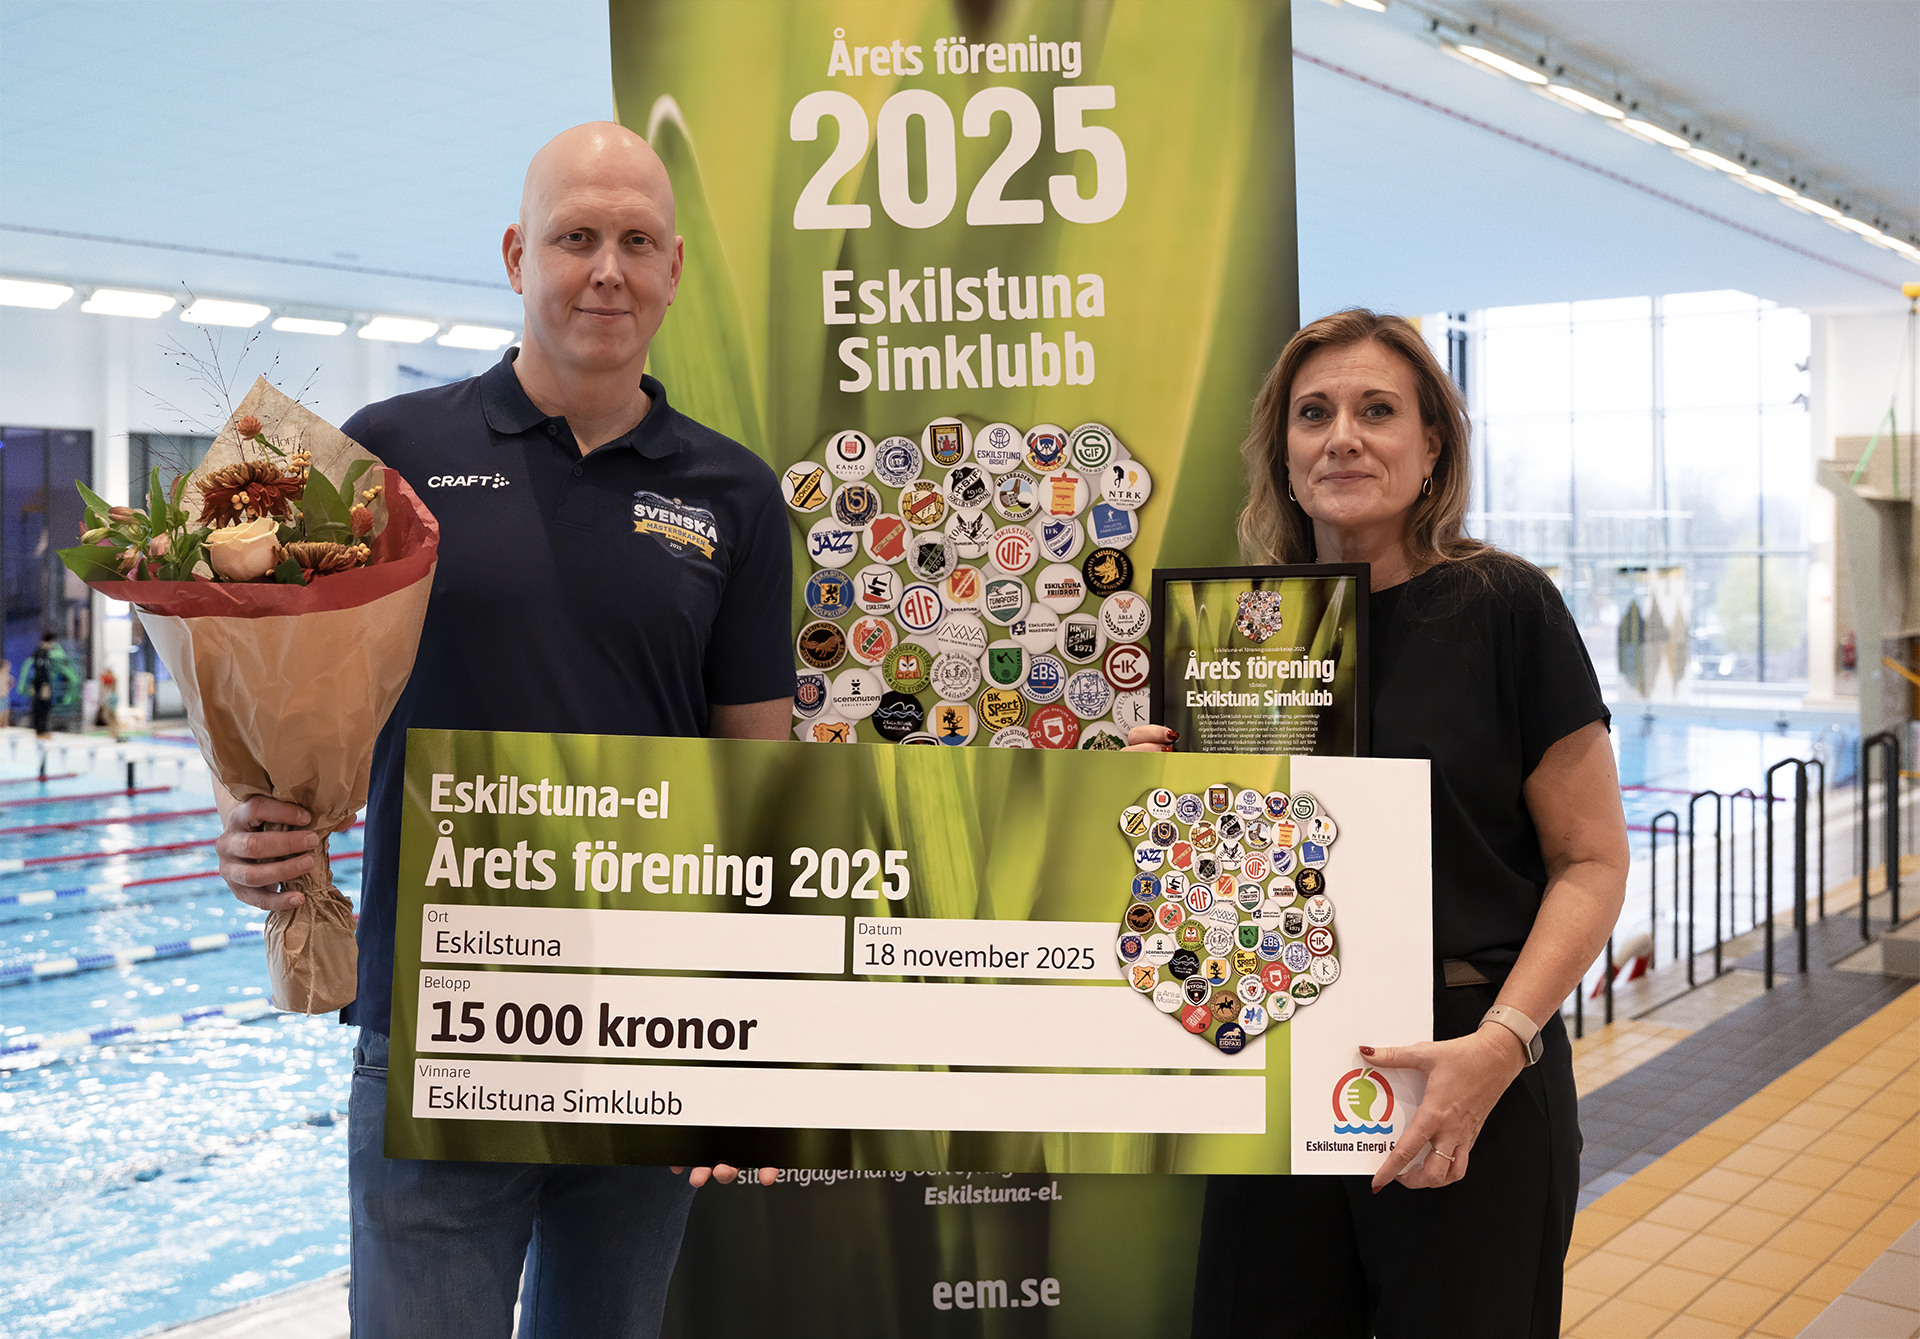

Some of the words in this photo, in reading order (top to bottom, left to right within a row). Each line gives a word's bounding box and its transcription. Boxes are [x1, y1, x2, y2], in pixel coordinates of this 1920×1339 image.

[827, 27, 924, 77] Årets
[933, 34, 1082, 79] förening
[789, 85, 1128, 230] 2025
[822, 266, 1105, 325] Eskilstuna
[838, 331, 1095, 393] Simklubb
[977, 450, 1020, 460] ESKILSTUNA
[1084, 448, 1100, 458] GIF
[428, 475, 492, 488] CRAFT
[1108, 490, 1142, 499] NTRK
[633, 504, 718, 543] SVENSKA
[994, 527, 1034, 542] ESKILSTUNA
[1050, 527, 1072, 548] ESKILSTUNA
[1097, 535, 1134, 546] ESKILSTUNA
[812, 532, 854, 556] JAZZ
[812, 569, 849, 584] ESKILSTUNA
[989, 595, 1019, 606] TUNAFORS
[812, 605, 848, 617] GOLFKLUBB
[1068, 630, 1094, 647] ESKIL
[1031, 664, 1057, 680] EBS
[1184, 650, 1241, 680] Årets
[1246, 655, 1335, 683] förening
[890, 681, 926, 693] ESKILSTUNA
[833, 695, 880, 703] scenknuten
[988, 693, 1001, 702] BK
[1186, 691, 1260, 708] Eskilstuna
[1263, 690, 1333, 707] Simklubb
[988, 699, 1019, 717] Sport
[1030, 730, 1042, 739] 20
[1067, 724, 1078, 732] 04
[995, 729, 1030, 745] ESKILSTUNA
[430, 774, 669, 819] Eskilstuna-el
[425, 820, 556, 890] Årets
[572, 840, 773, 906] förening
[789, 847, 910, 900] 2025
[1137, 849, 1162, 864] JAZZ
[427, 910, 449, 924] Ort
[858, 923, 902, 936] Datum
[435, 930, 562, 958] Eskilstuna
[1263, 939, 1279, 947] EBS
[865, 943, 895, 966] 18
[904, 944, 1029, 968] november
[1036, 946, 1095, 970] 2025
[424, 976, 471, 992] Belopp
[430, 1000, 486, 1043] 15
[496, 1002, 584, 1045] 000
[599, 1002, 758, 1050] kronor
[419, 1065, 471, 1078] Vinnare
[428, 1086, 555, 1112] Eskilstuna
[563, 1089, 682, 1116] Simklubb
[1306, 1141, 1354, 1152] Eskilstuna
[1357, 1142, 1387, 1154] Energi
[924, 1181, 1062, 1205] Eskilstuna-el.
[932, 1277, 1060, 1310] eem.se
